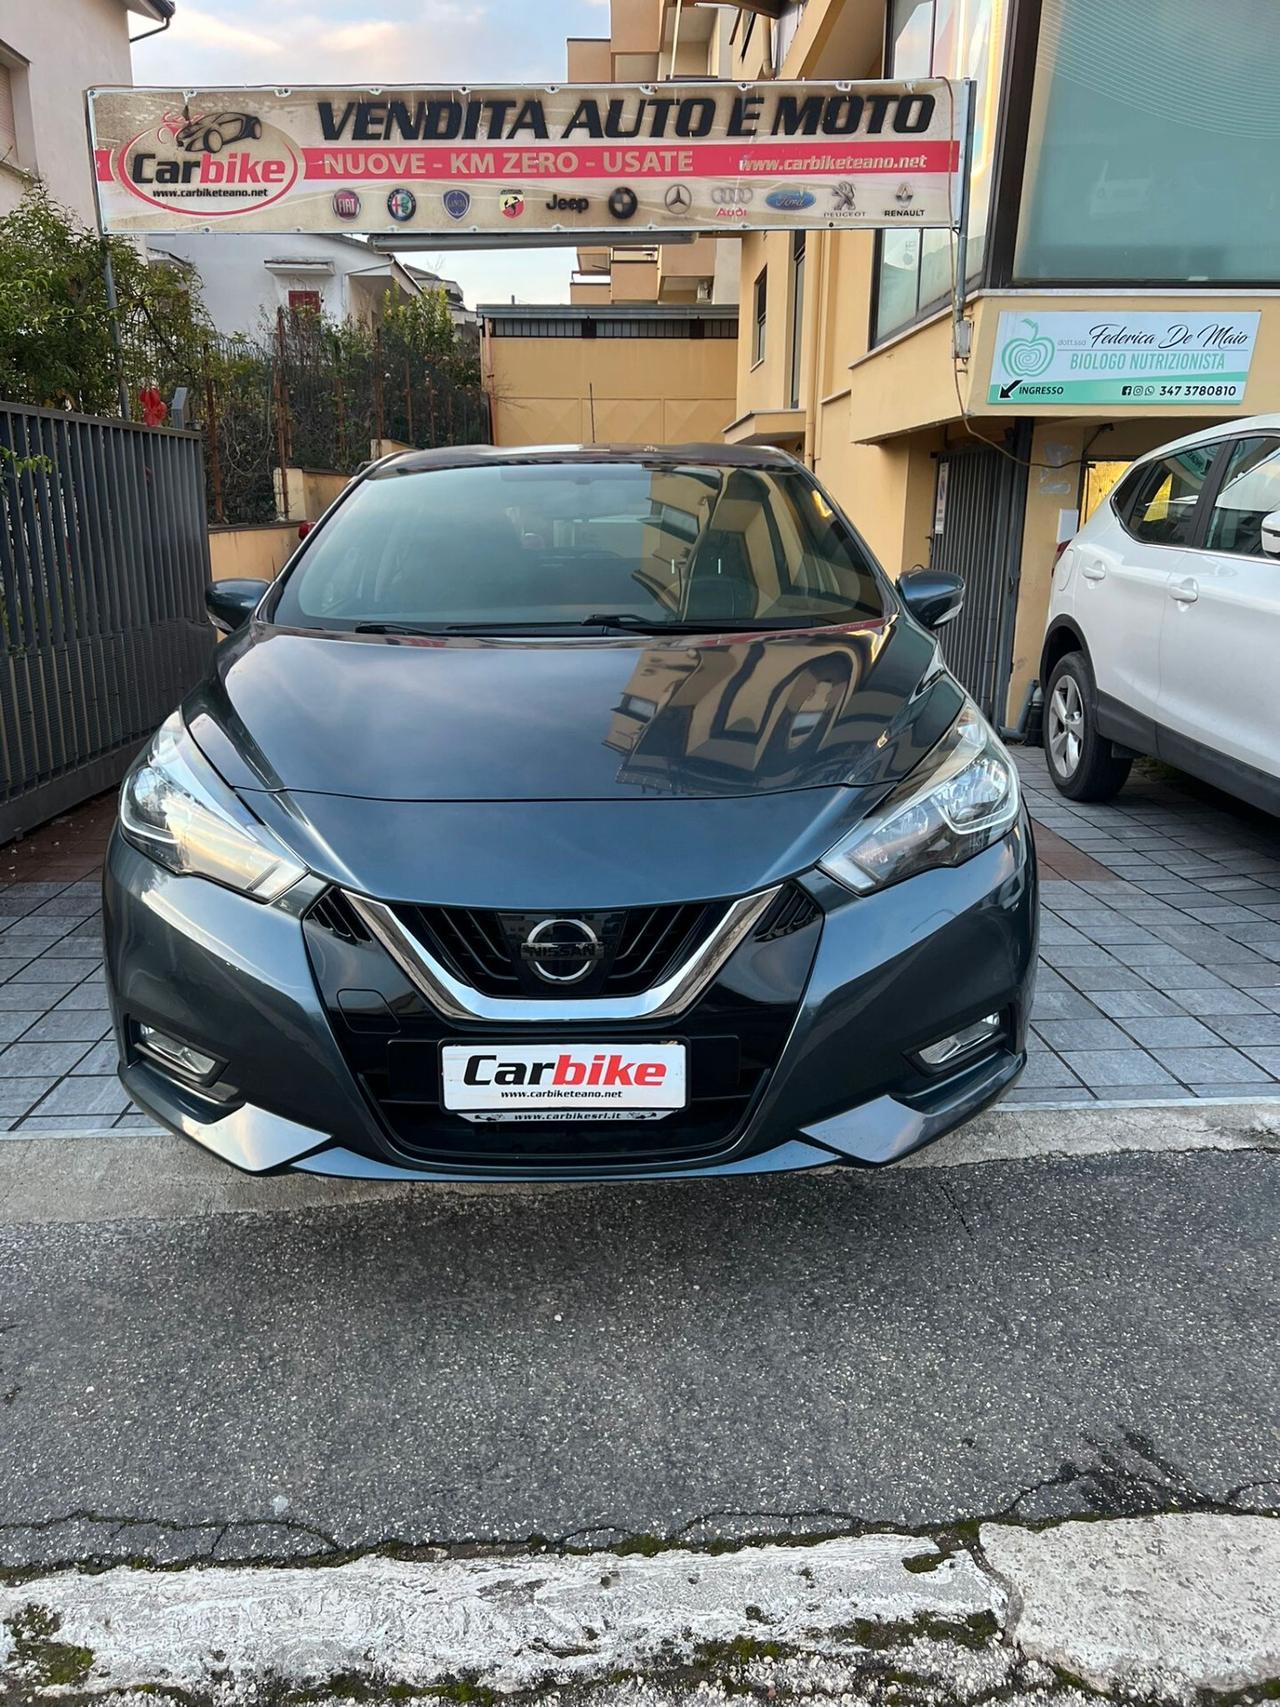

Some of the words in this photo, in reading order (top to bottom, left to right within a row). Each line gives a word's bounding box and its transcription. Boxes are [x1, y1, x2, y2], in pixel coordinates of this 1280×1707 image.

[317, 101, 549, 140] VENDITA
[561, 99, 716, 138] AUTO
[727, 96, 765, 137] E
[771, 94, 936, 135] MOTO
[132, 152, 286, 184] Carbike
[324, 153, 426, 174] NUOVE
[451, 153, 495, 174] KM
[502, 151, 579, 173] ZERO
[603, 151, 693, 172] USATE
[739, 153, 928, 172] www.carbiketeano.net
[152, 187, 269, 199] www.carbiketeano.net
[545, 194, 589, 214] Jeep
[716, 206, 747, 217] Audi
[884, 209, 925, 217] RENAULT
[1088, 323, 1157, 348] Federica
[1158, 324, 1193, 349] De
[1197, 323, 1249, 349] Maio
[1070, 353, 1125, 370] BIOLOGO
[1129, 352, 1225, 370] NUTRIZIONISTA
[1018, 386, 1064, 395] INGRESSO
[1159, 385, 1181, 396] 347
[1184, 385, 1237, 396] 3780810
[463, 1054, 667, 1086] Carbike
[501, 1089, 622, 1099] www.carbiketeano.net
[514, 1112, 621, 1121] www.carbikesrl.it
